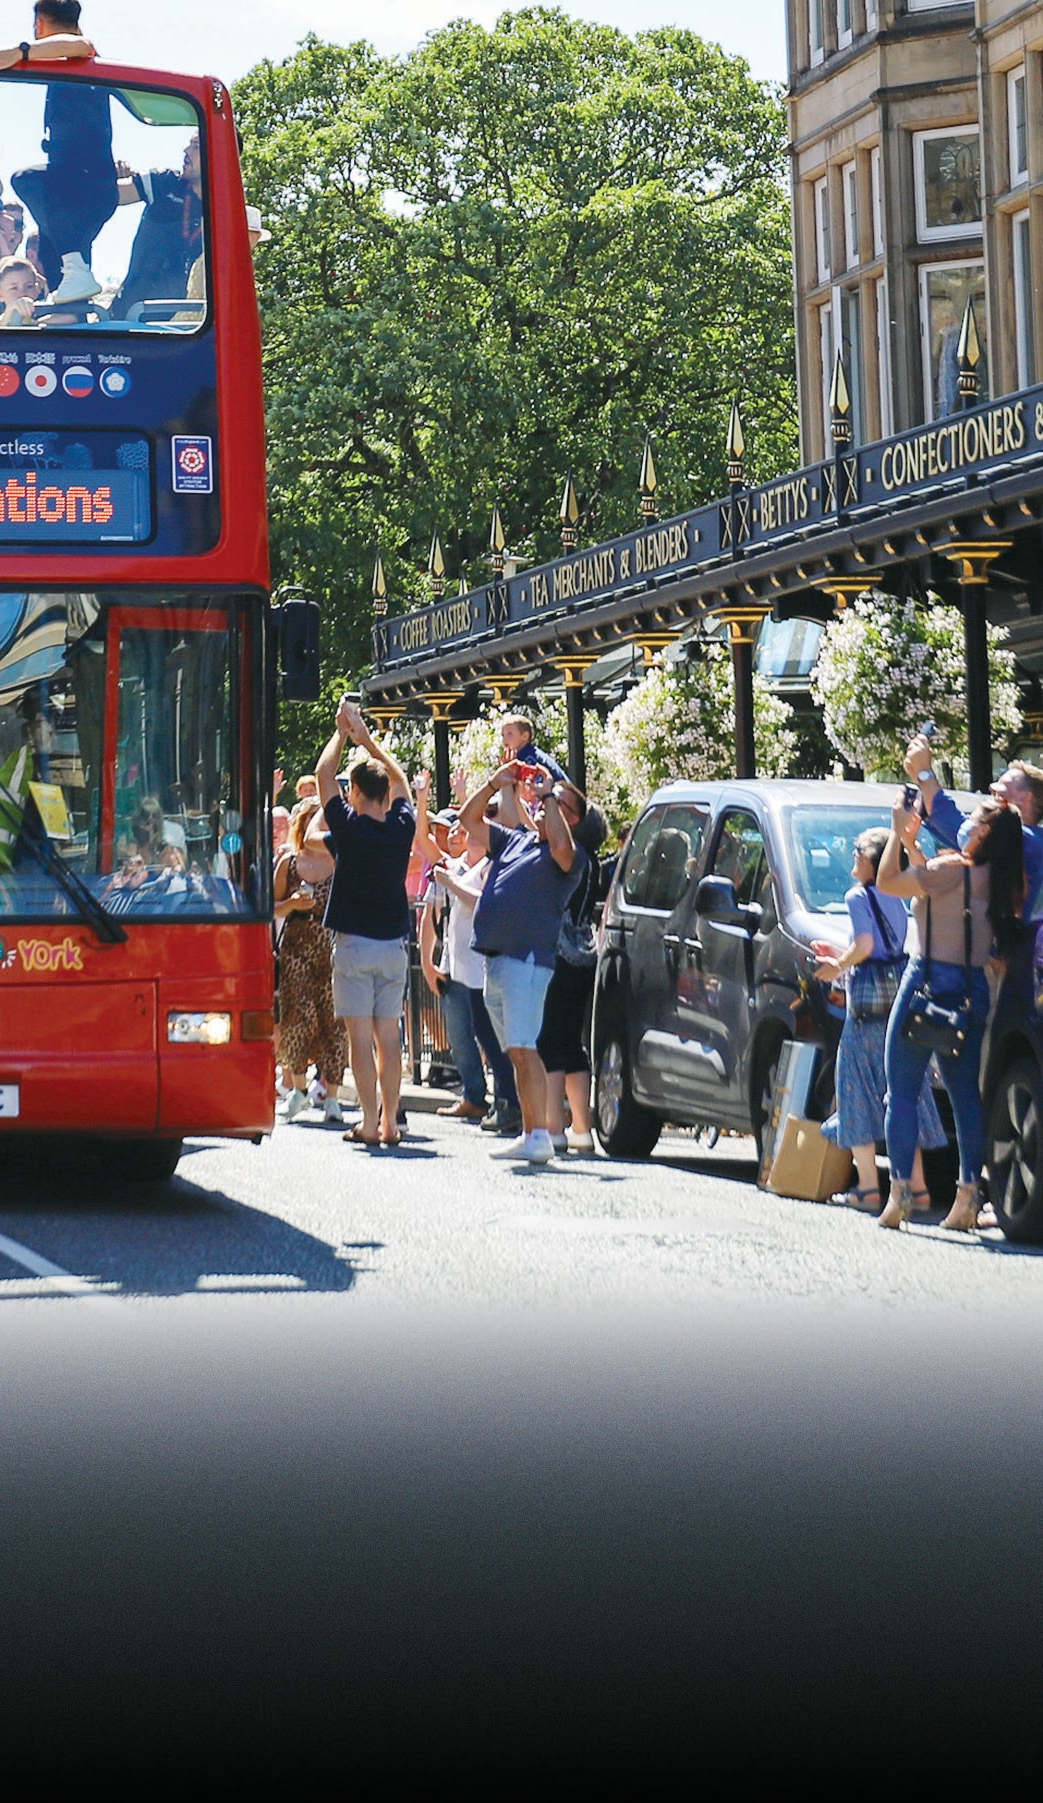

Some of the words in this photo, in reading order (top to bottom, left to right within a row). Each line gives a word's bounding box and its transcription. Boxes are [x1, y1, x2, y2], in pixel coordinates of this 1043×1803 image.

[881, 400, 1025, 491] CONFECTIONERS
[760, 477, 809, 532] BETTYS
[529, 573, 549, 609] TEA
[552, 548, 616, 602] MERCHANTS
[620, 549, 630, 579] &
[635, 520, 689, 574] BLENDERS
[400, 615, 429, 652] COFFEE
[432, 598, 472, 642] ROASTERS
